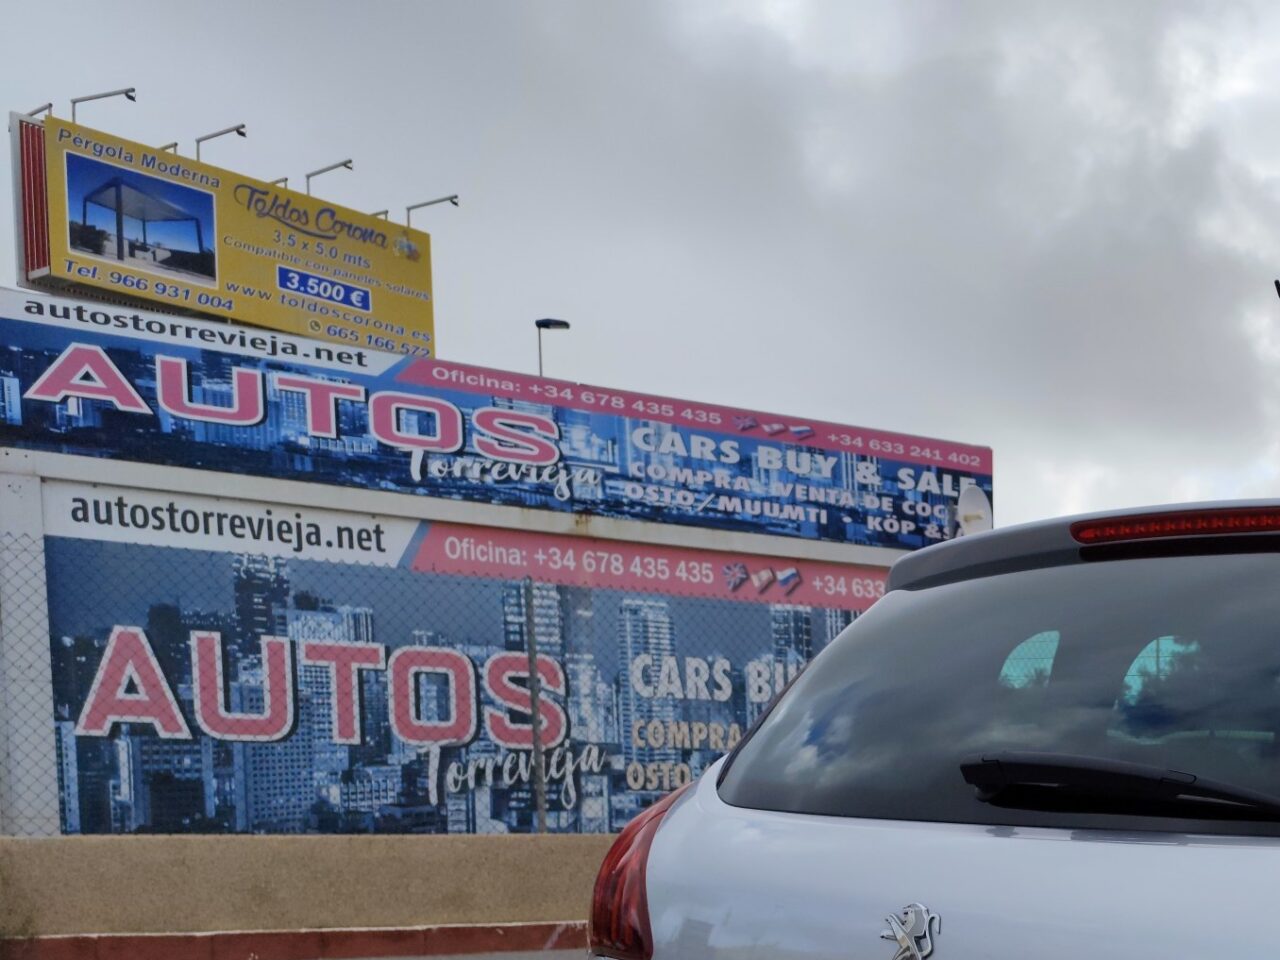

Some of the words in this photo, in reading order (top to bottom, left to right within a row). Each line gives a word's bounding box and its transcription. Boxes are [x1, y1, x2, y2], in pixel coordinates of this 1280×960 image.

[58, 128, 134, 164] Pérgola
[141, 152, 220, 188] Moderna
[233, 183, 309, 227] Toldos
[315, 207, 389, 250] Corona
[223, 235, 300, 266] Compatible
[305, 259, 329, 273] con
[333, 266, 381, 289] paneles
[385, 281, 430, 301] solares
[273, 229, 296, 248] 3.5
[301, 239, 309, 251] x
[315, 241, 338, 260] 5.0
[343, 252, 371, 270] mts
[64, 259, 102, 281] Tel.
[109, 271, 149, 291] 966
[154, 282, 190, 301] 931
[197, 293, 233, 311] 004
[286, 271, 345, 302] 3.500
[350, 289, 365, 307] €
[24, 299, 367, 368] autostorrevieja.net
[326, 324, 359, 343] 665
[366, 333, 396, 353] 166
[400, 346, 430, 360] 572
[23, 341, 560, 465] AUTOS
[432, 366, 521, 393] Oficina:
[529, 381, 574, 402] +34
[580, 390, 625, 410] 678
[631, 400, 675, 418] 435
[681, 408, 722, 425] 435
[827, 432, 864, 448] +34
[868, 438, 905, 456] 633
[909, 446, 943, 462] 241
[947, 452, 980, 467] 402
[408, 449, 602, 501] Torrevieja
[632, 426, 740, 464] CARS
[757, 445, 838, 479] BUY
[855, 461, 882, 486] &
[631, 460, 750, 492] COMPRA
[775, 482, 855, 507] VENTA
[864, 494, 894, 513] DE
[901, 500, 948, 520] COC
[70, 496, 387, 553] autostorrevieja.net
[866, 514, 917, 535] KÖP
[444, 536, 528, 567] Oficina:
[534, 547, 576, 571] +34
[582, 550, 625, 576] 678
[630, 556, 670, 580] 435
[675, 560, 714, 584] 435
[812, 575, 847, 597] +34
[852, 577, 887, 599] 633
[74, 624, 568, 749] AUTOS
[631, 653, 733, 702] CARS
[632, 719, 743, 750] COMPRA
[626, 761, 693, 791] OSTO
